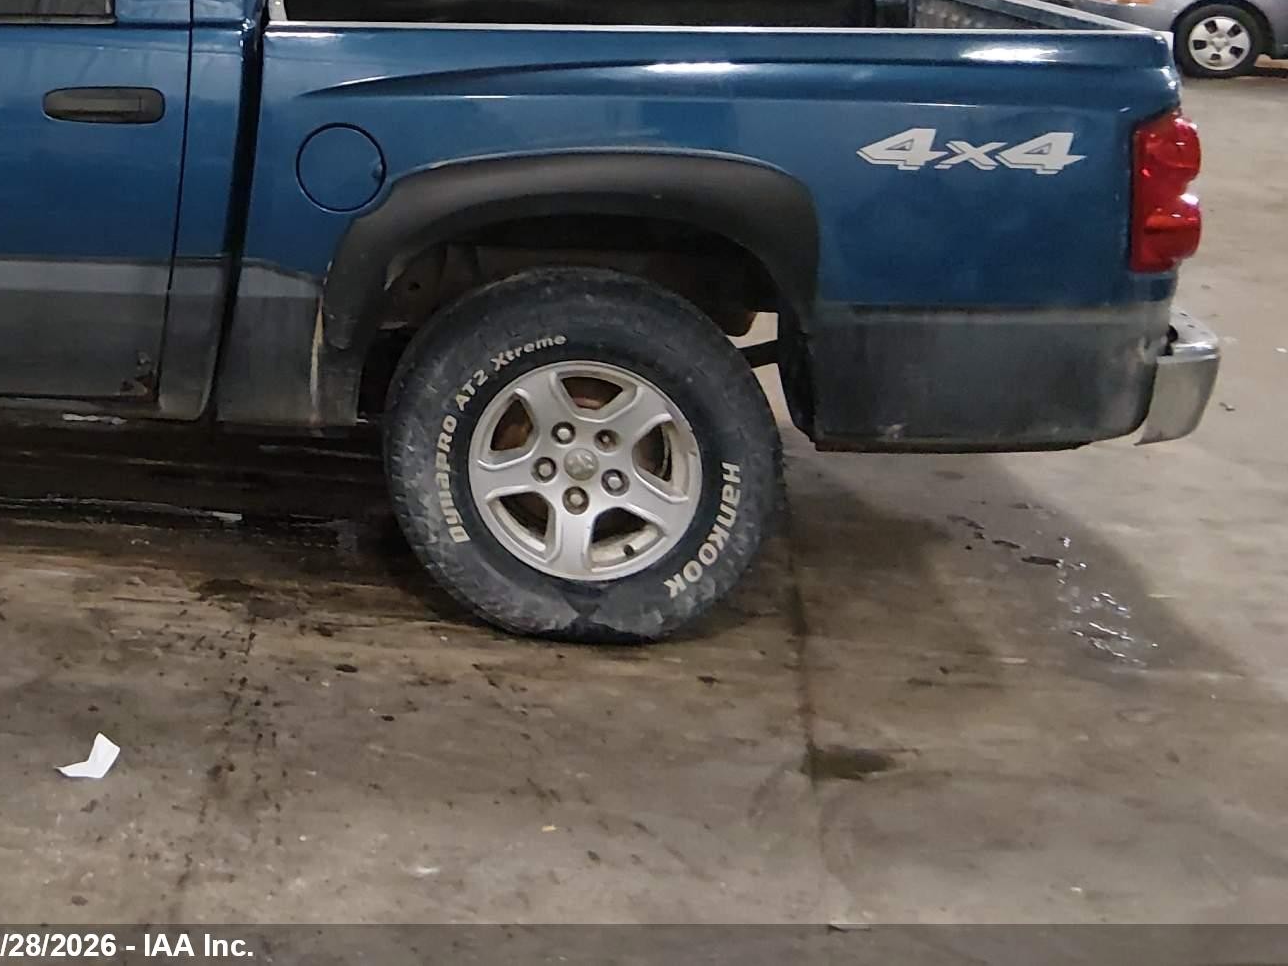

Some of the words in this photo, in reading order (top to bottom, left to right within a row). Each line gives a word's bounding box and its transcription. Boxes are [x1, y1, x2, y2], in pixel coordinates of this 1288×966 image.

[855, 128, 1089, 175] 4x4
[455, 369, 489, 411] AT2
[490, 334, 567, 372] Xtreme
